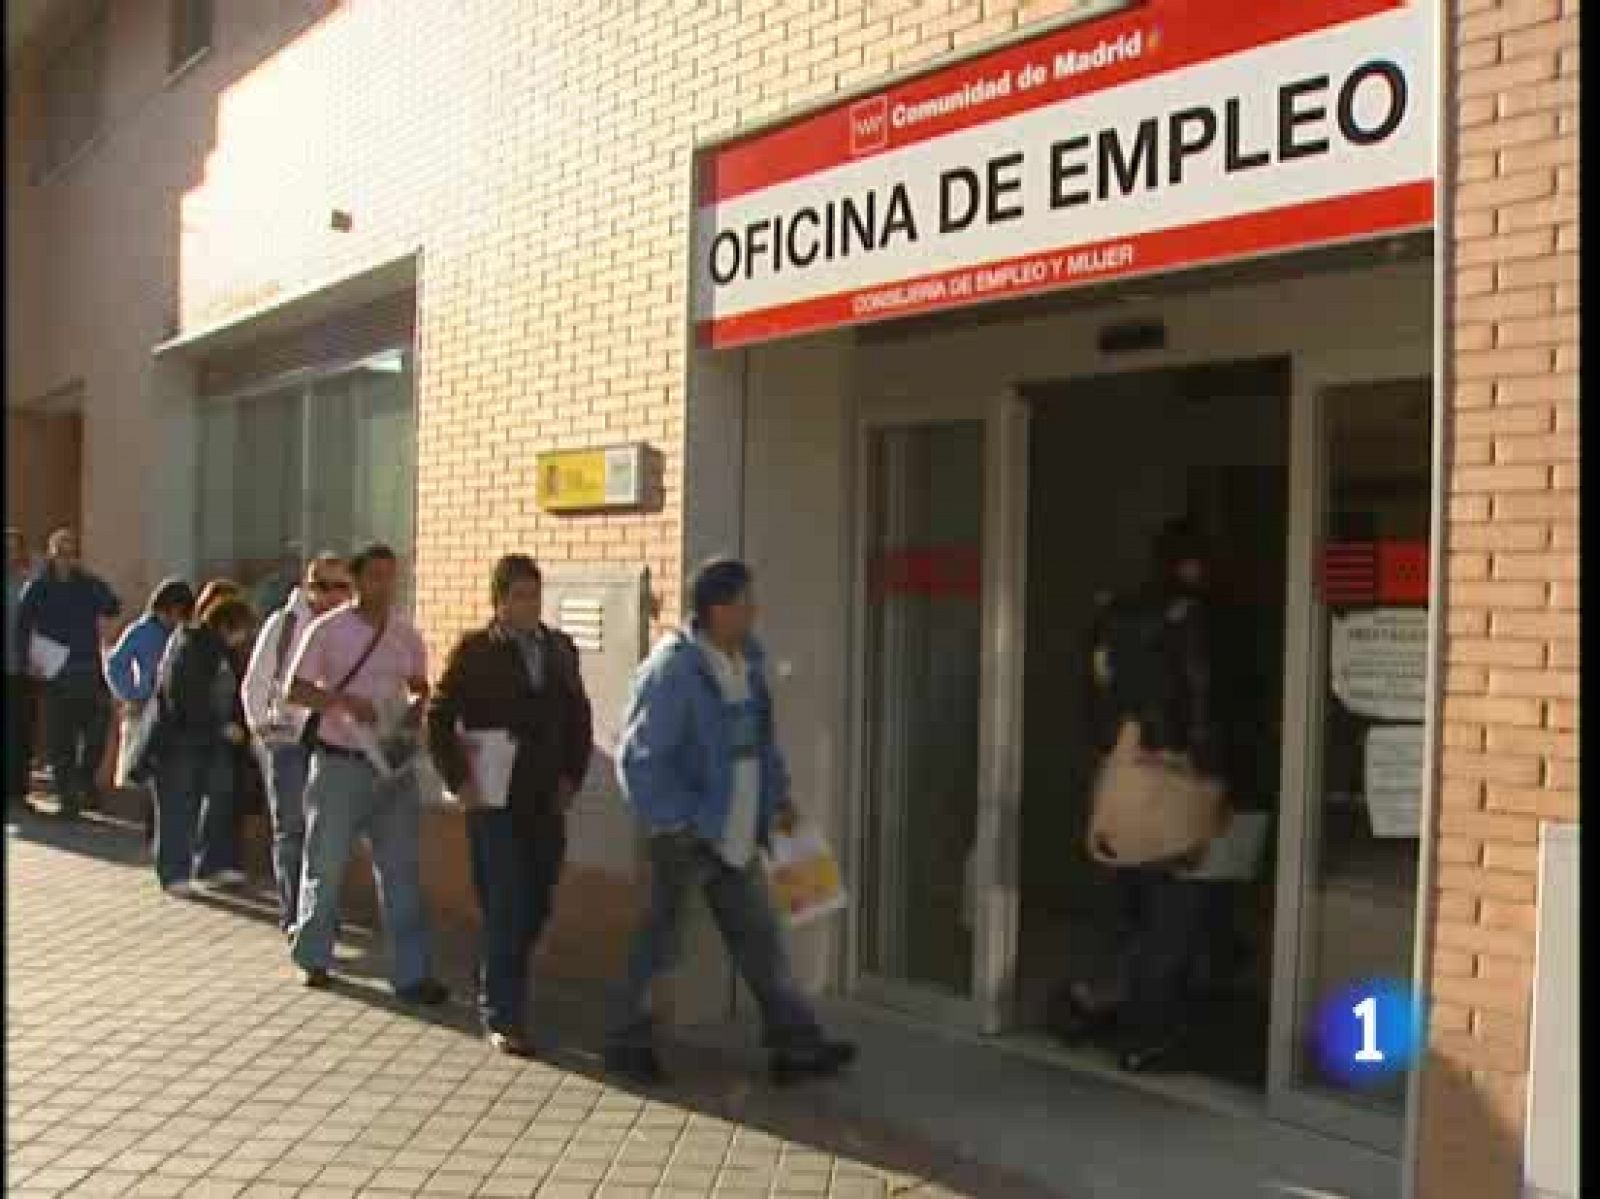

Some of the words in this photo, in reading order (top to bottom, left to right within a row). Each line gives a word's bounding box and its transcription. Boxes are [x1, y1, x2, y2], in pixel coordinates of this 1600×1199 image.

[892, 69, 1011, 128] Comunidad
[1018, 62, 1048, 90] de
[1053, 29, 1142, 79] Madrid
[709, 183, 918, 285] OFICINA
[938, 153, 1024, 234] DE
[1050, 60, 1408, 210] EMPLEO
[950, 270, 974, 297] DE
[976, 260, 1045, 294] EMPLEO
[1049, 257, 1064, 280] Y
[1066, 243, 1133, 277] MUJER
